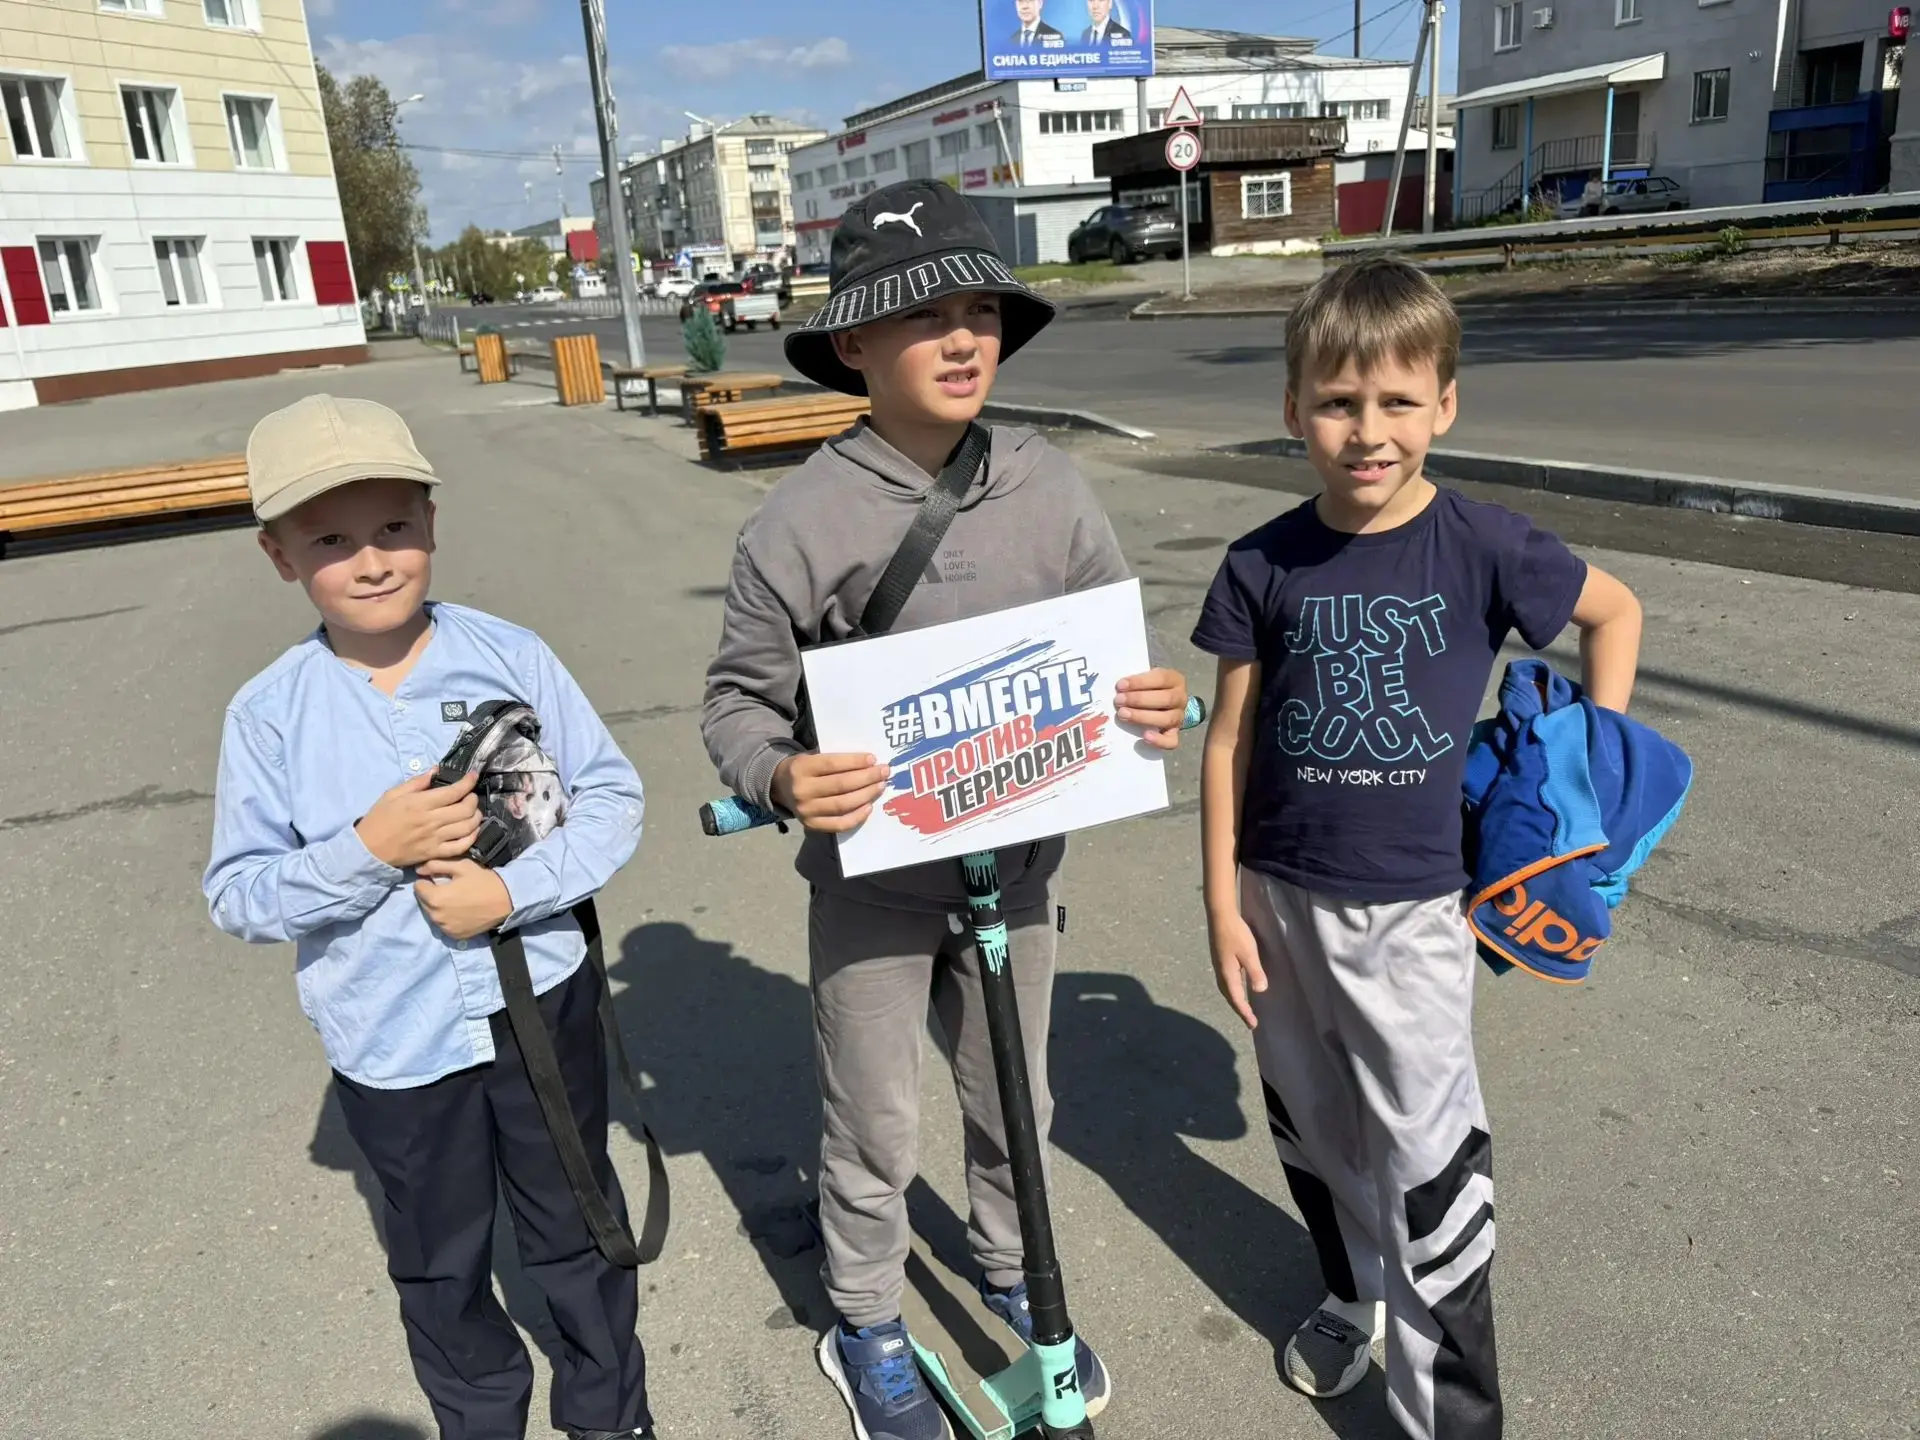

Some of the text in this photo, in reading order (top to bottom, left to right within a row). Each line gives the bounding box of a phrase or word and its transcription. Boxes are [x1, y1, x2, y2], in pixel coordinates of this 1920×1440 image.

[1894, 15, 1909, 28] WB
[992, 54, 1025, 66] СИЛА
[1029, 54, 1038, 65] В
[1040, 53, 1101, 67] ЕДИНСТВЕ
[1174, 143, 1193, 158] 20
[943, 550, 965, 559] ONLY
[944, 560, 976, 571] LOVE IS
[1284, 593, 1446, 656] JUST
[1313, 650, 1409, 712] BE
[882, 656, 1092, 748] #ВМЕСТЕ
[1278, 699, 1454, 762] COOL
[912, 715, 1036, 796] ПРОТИВ
[936, 728, 1085, 820] ТЕРРОРА!
[1297, 766, 1426, 786] NEW YORK CITY
